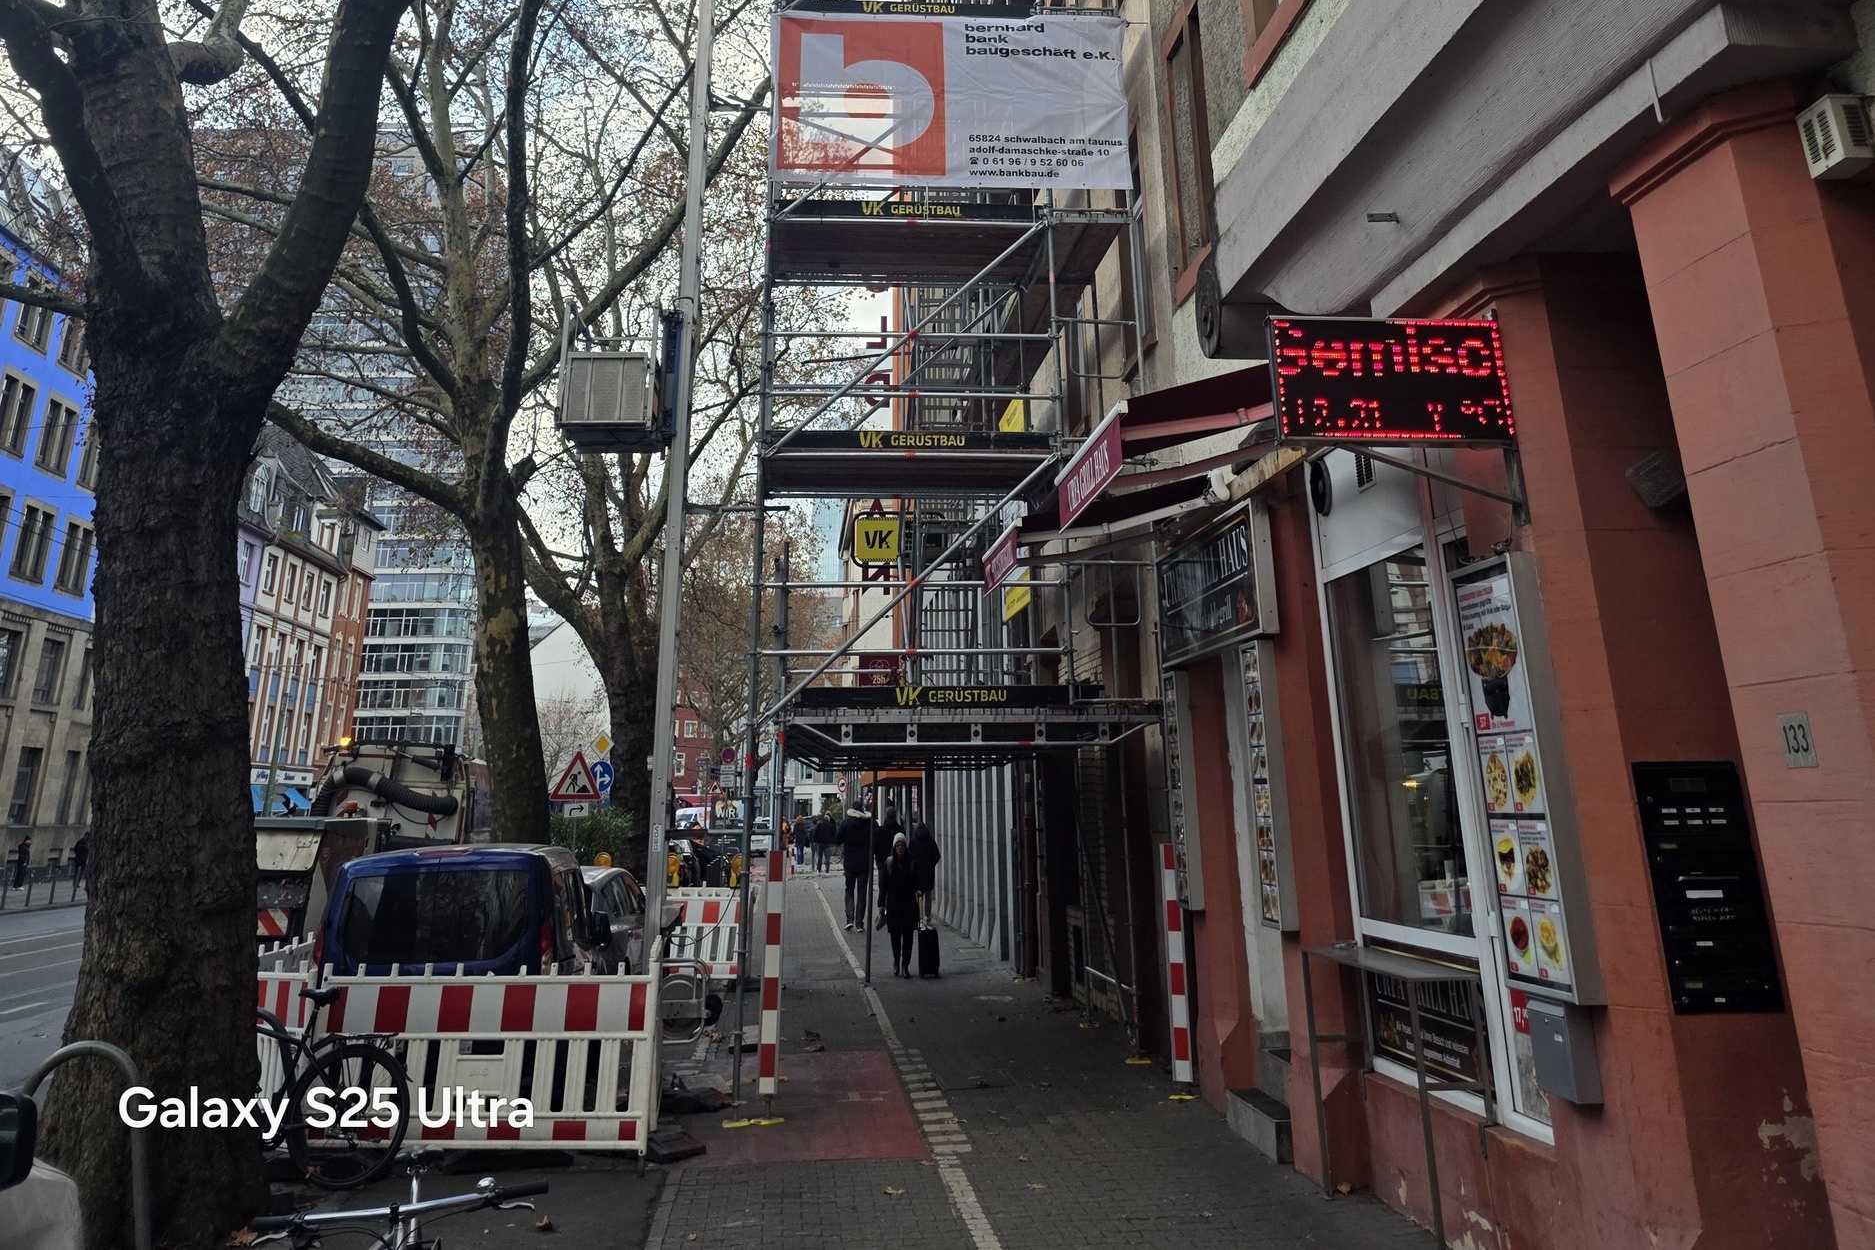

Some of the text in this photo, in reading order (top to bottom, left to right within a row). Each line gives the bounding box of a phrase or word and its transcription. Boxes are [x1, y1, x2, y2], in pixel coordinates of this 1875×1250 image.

[862, 0, 955, 14] VK GERÜSTBAU
[964, 22, 1045, 33] bernhard
[965, 33, 1009, 44] bank
[966, 46, 1077, 60] baugeschäft
[968, 134, 1001, 143] 65824
[1004, 135, 1066, 145] schwalbach
[1088, 137, 1123, 147] taunus
[968, 146, 1110, 157] adolf-damaschke-straße 10
[982, 157, 989, 166] 0
[992, 157, 1004, 166] 61
[1008, 157, 1021, 166] 96
[1030, 157, 1037, 166] 9
[1040, 157, 1053, 166] 52
[1071, 158, 1084, 167] 06
[969, 168, 1060, 178] www.bankbau.de
[861, 200, 961, 216] VK GERÜSTBAU
[859, 430, 966, 448] VK GERÜSTBAU
[865, 530, 894, 549] VK
[1218, 525, 1248, 580] HAUS
[895, 686, 1007, 706] VK GERÜSTBAU
[1781, 724, 1810, 755] 133
